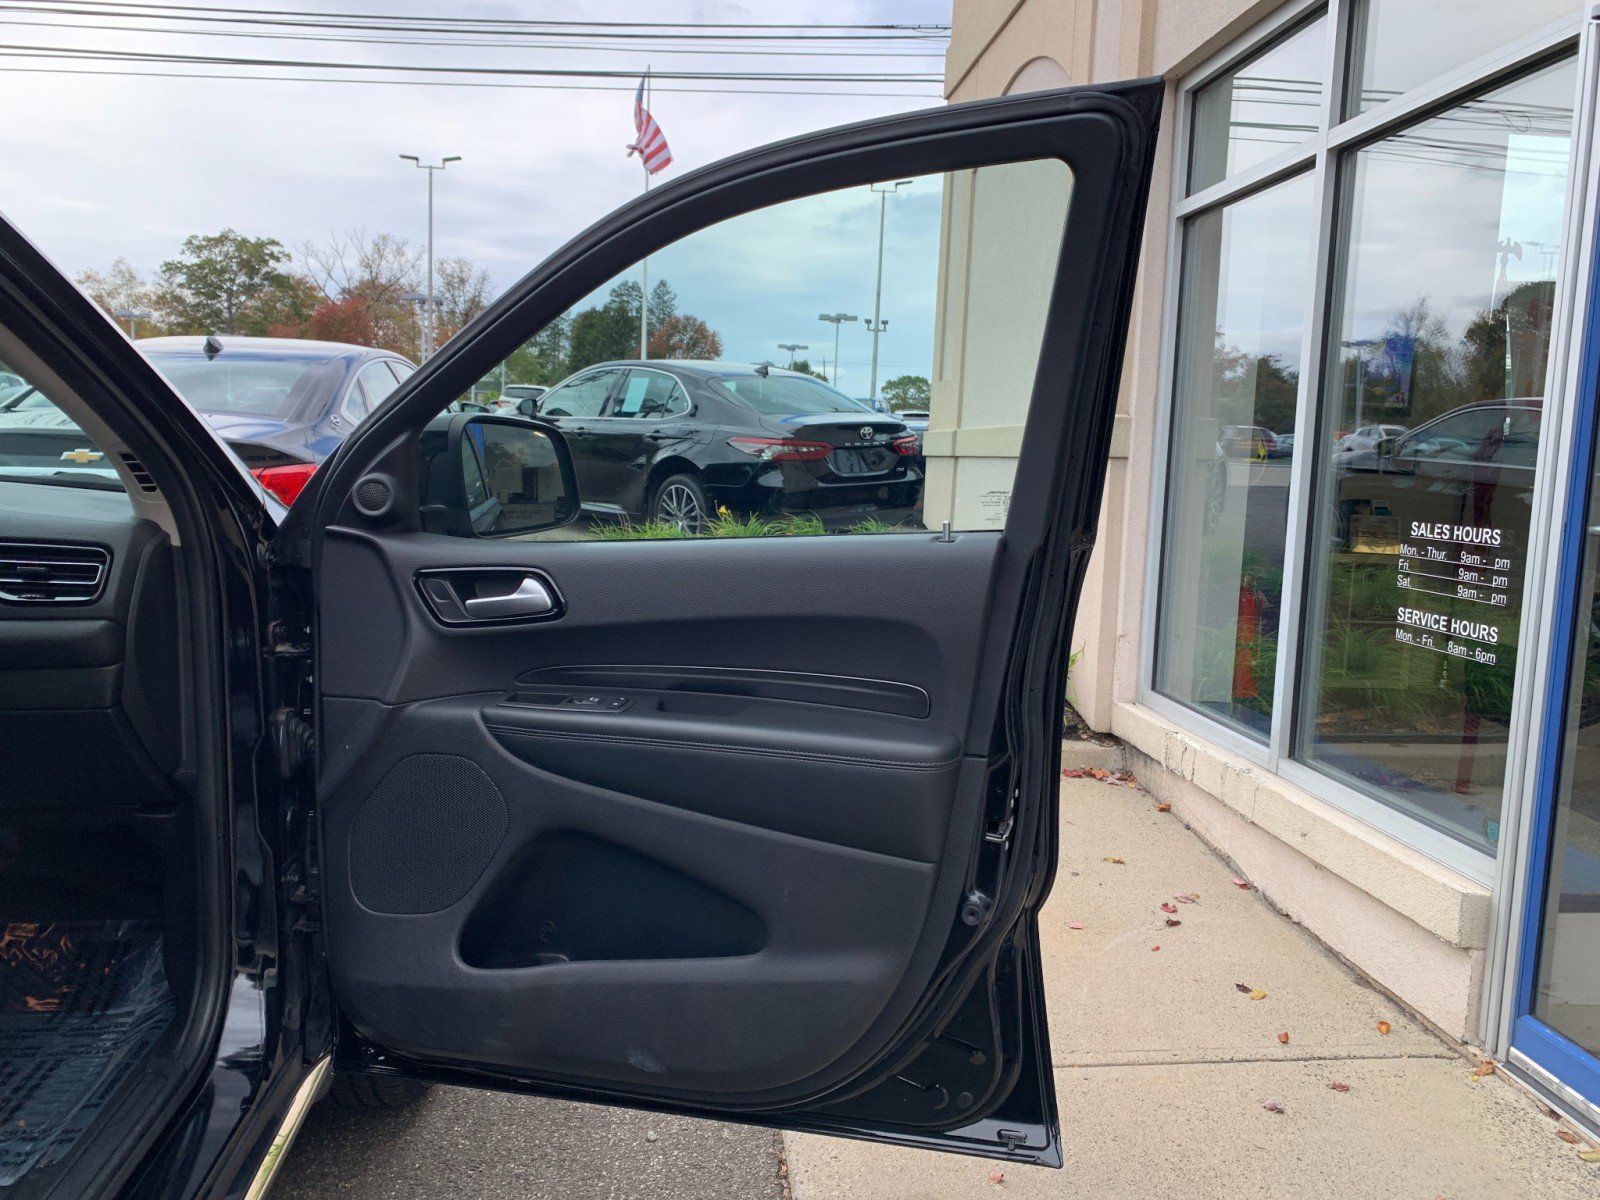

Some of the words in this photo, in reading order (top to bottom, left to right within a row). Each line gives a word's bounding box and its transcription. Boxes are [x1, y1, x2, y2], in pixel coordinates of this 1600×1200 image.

[1410, 521, 1450, 540] SALES
[1453, 525, 1501, 545] HOURS
[1400, 543, 1419, 557] Mon.
[1427, 547, 1447, 561] Thur.
[1460, 551, 1480, 565] 9am
[1495, 558, 1510, 569] pm
[1398, 558, 1411, 572] Fri.
[1458, 568, 1478, 582] 9am
[1492, 576, 1508, 587] pm
[1397, 574, 1412, 588] Sat.
[1457, 585, 1477, 599] 9am
[1491, 593, 1507, 605] pm
[1397, 606, 1448, 632] SERVICE
[1450, 618, 1499, 643] HOURS
[1395, 628, 1414, 643] Mon.
[1421, 634, 1435, 648] Fri.
[1447, 641, 1467, 656] 8am
[1475, 648, 1496, 663] 6pm
